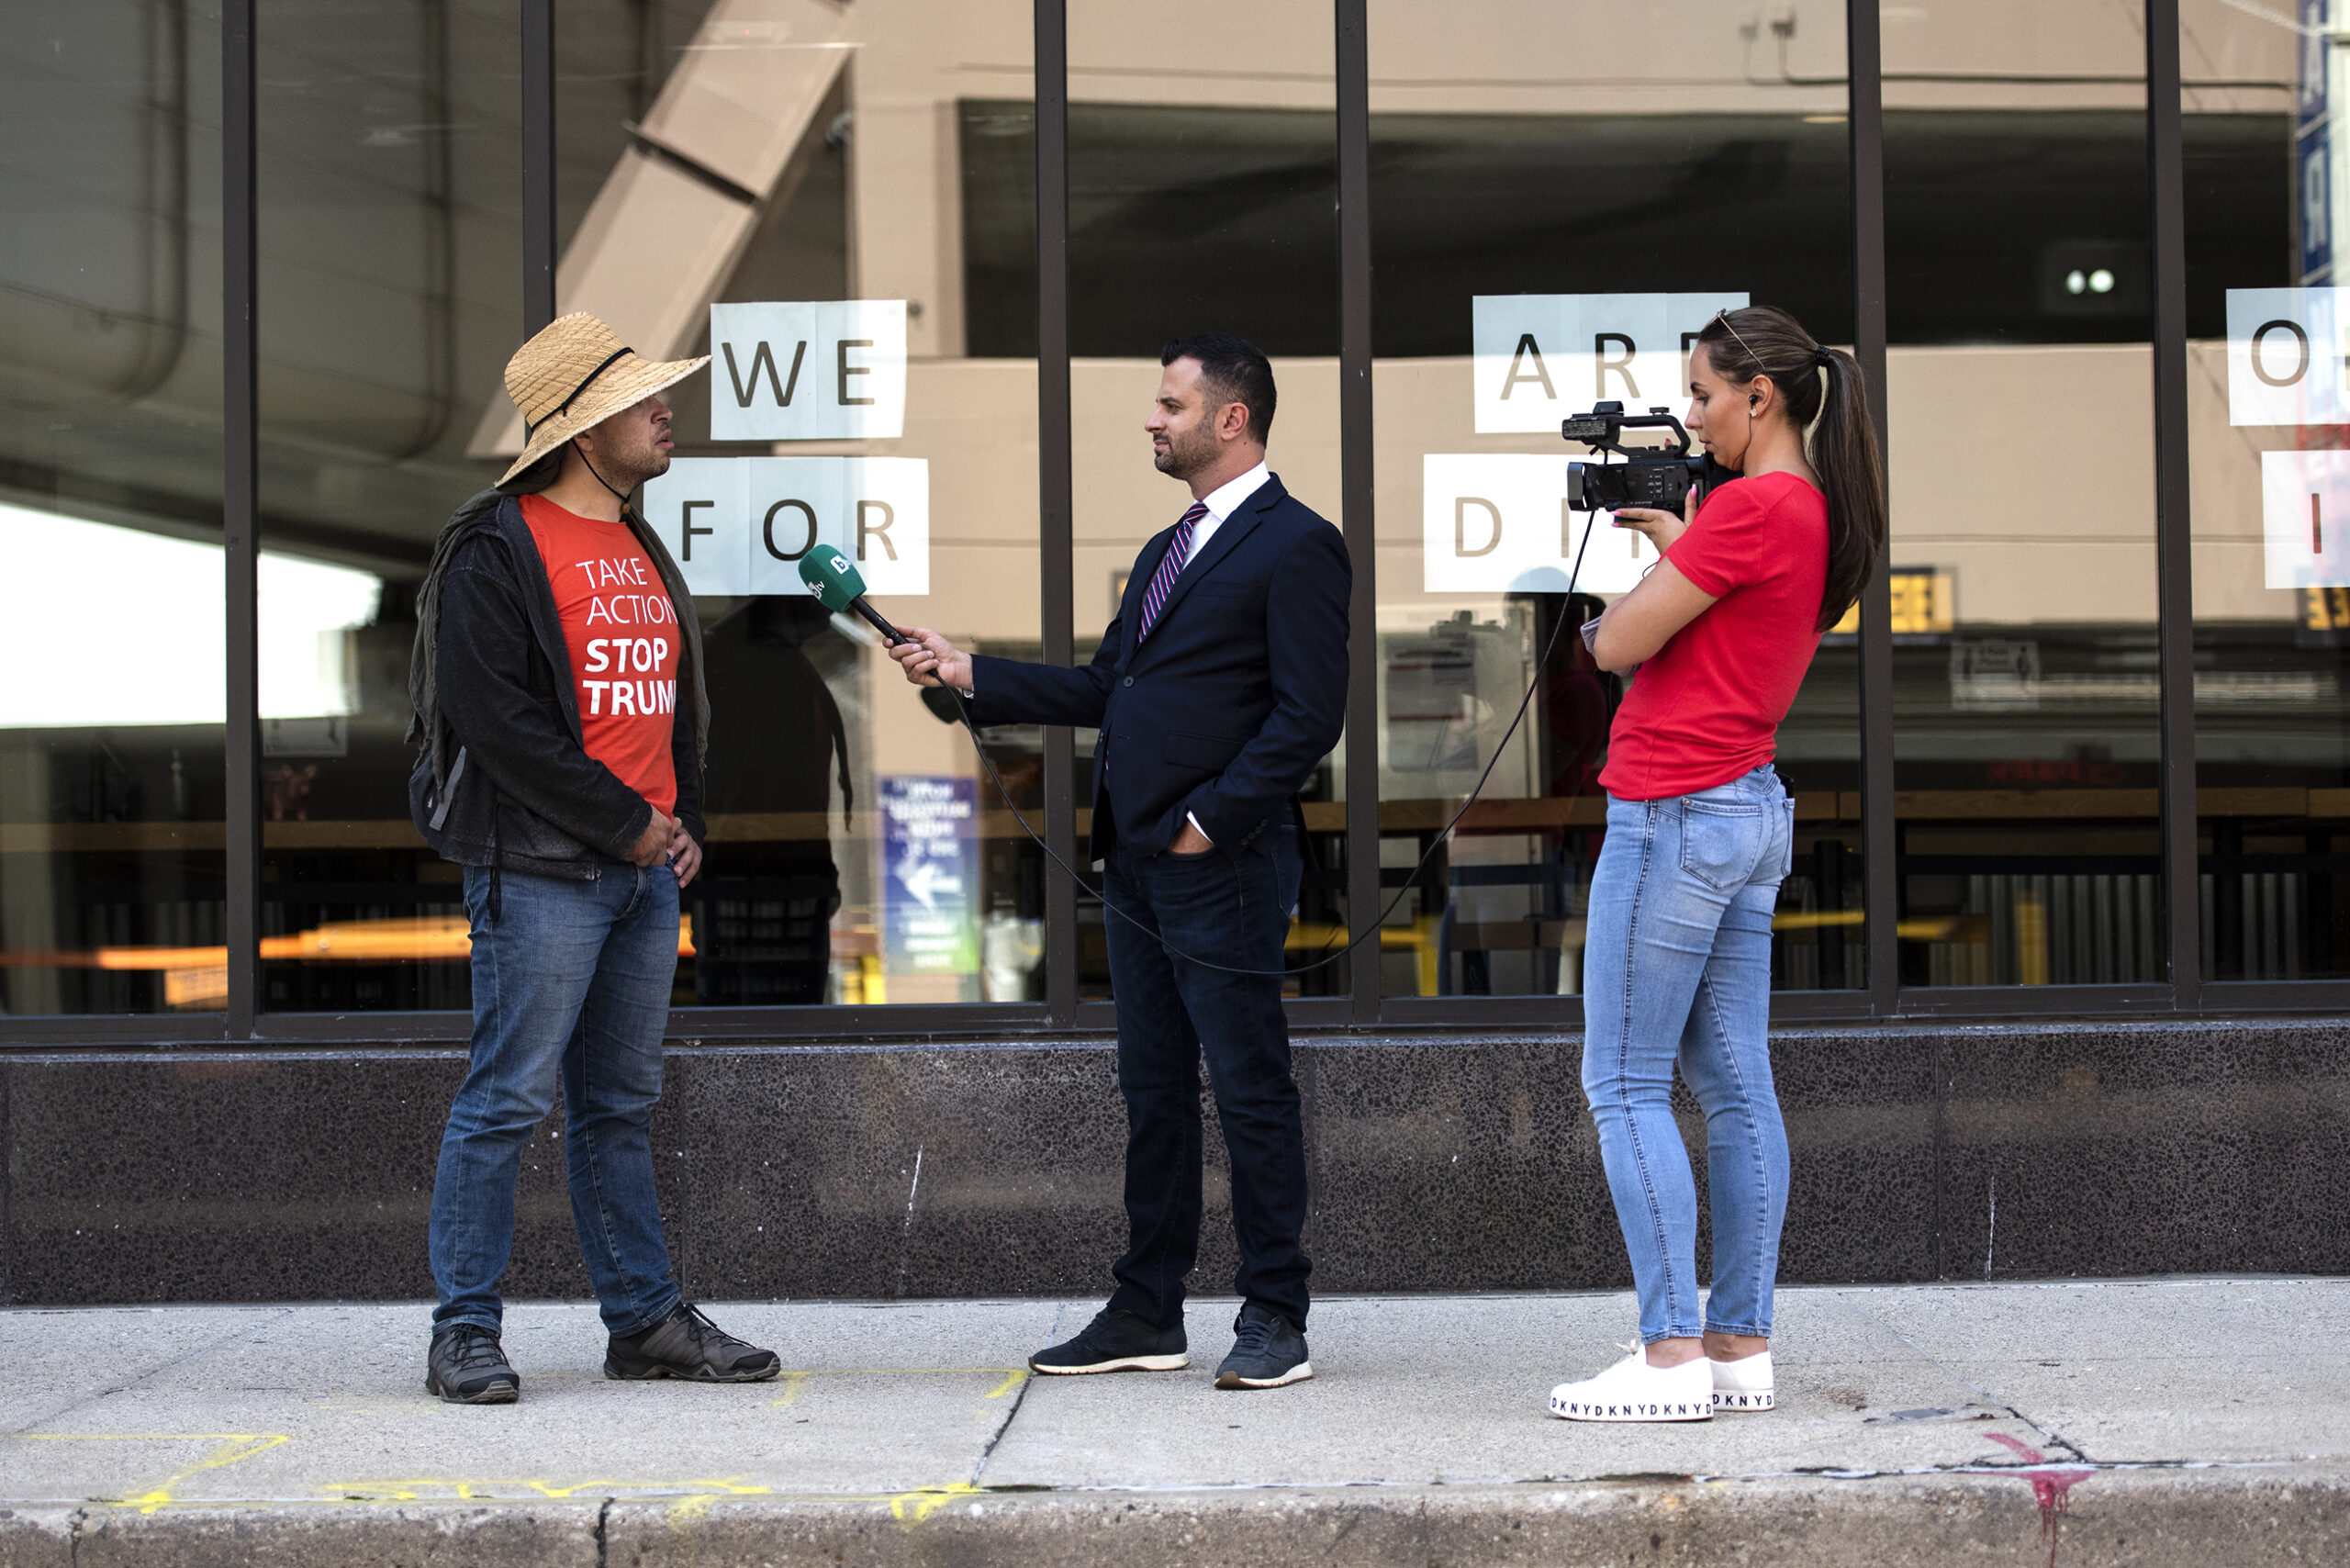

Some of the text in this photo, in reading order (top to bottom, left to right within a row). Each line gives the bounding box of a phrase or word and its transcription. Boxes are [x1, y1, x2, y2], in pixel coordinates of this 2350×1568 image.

[722, 340, 875, 408] WE
[682, 499, 897, 561] FOR
[576, 557, 647, 588] TAKE
[587, 595, 678, 625] ACTION
[584, 637, 668, 673] STOP
[582, 679, 677, 715] TRUM
